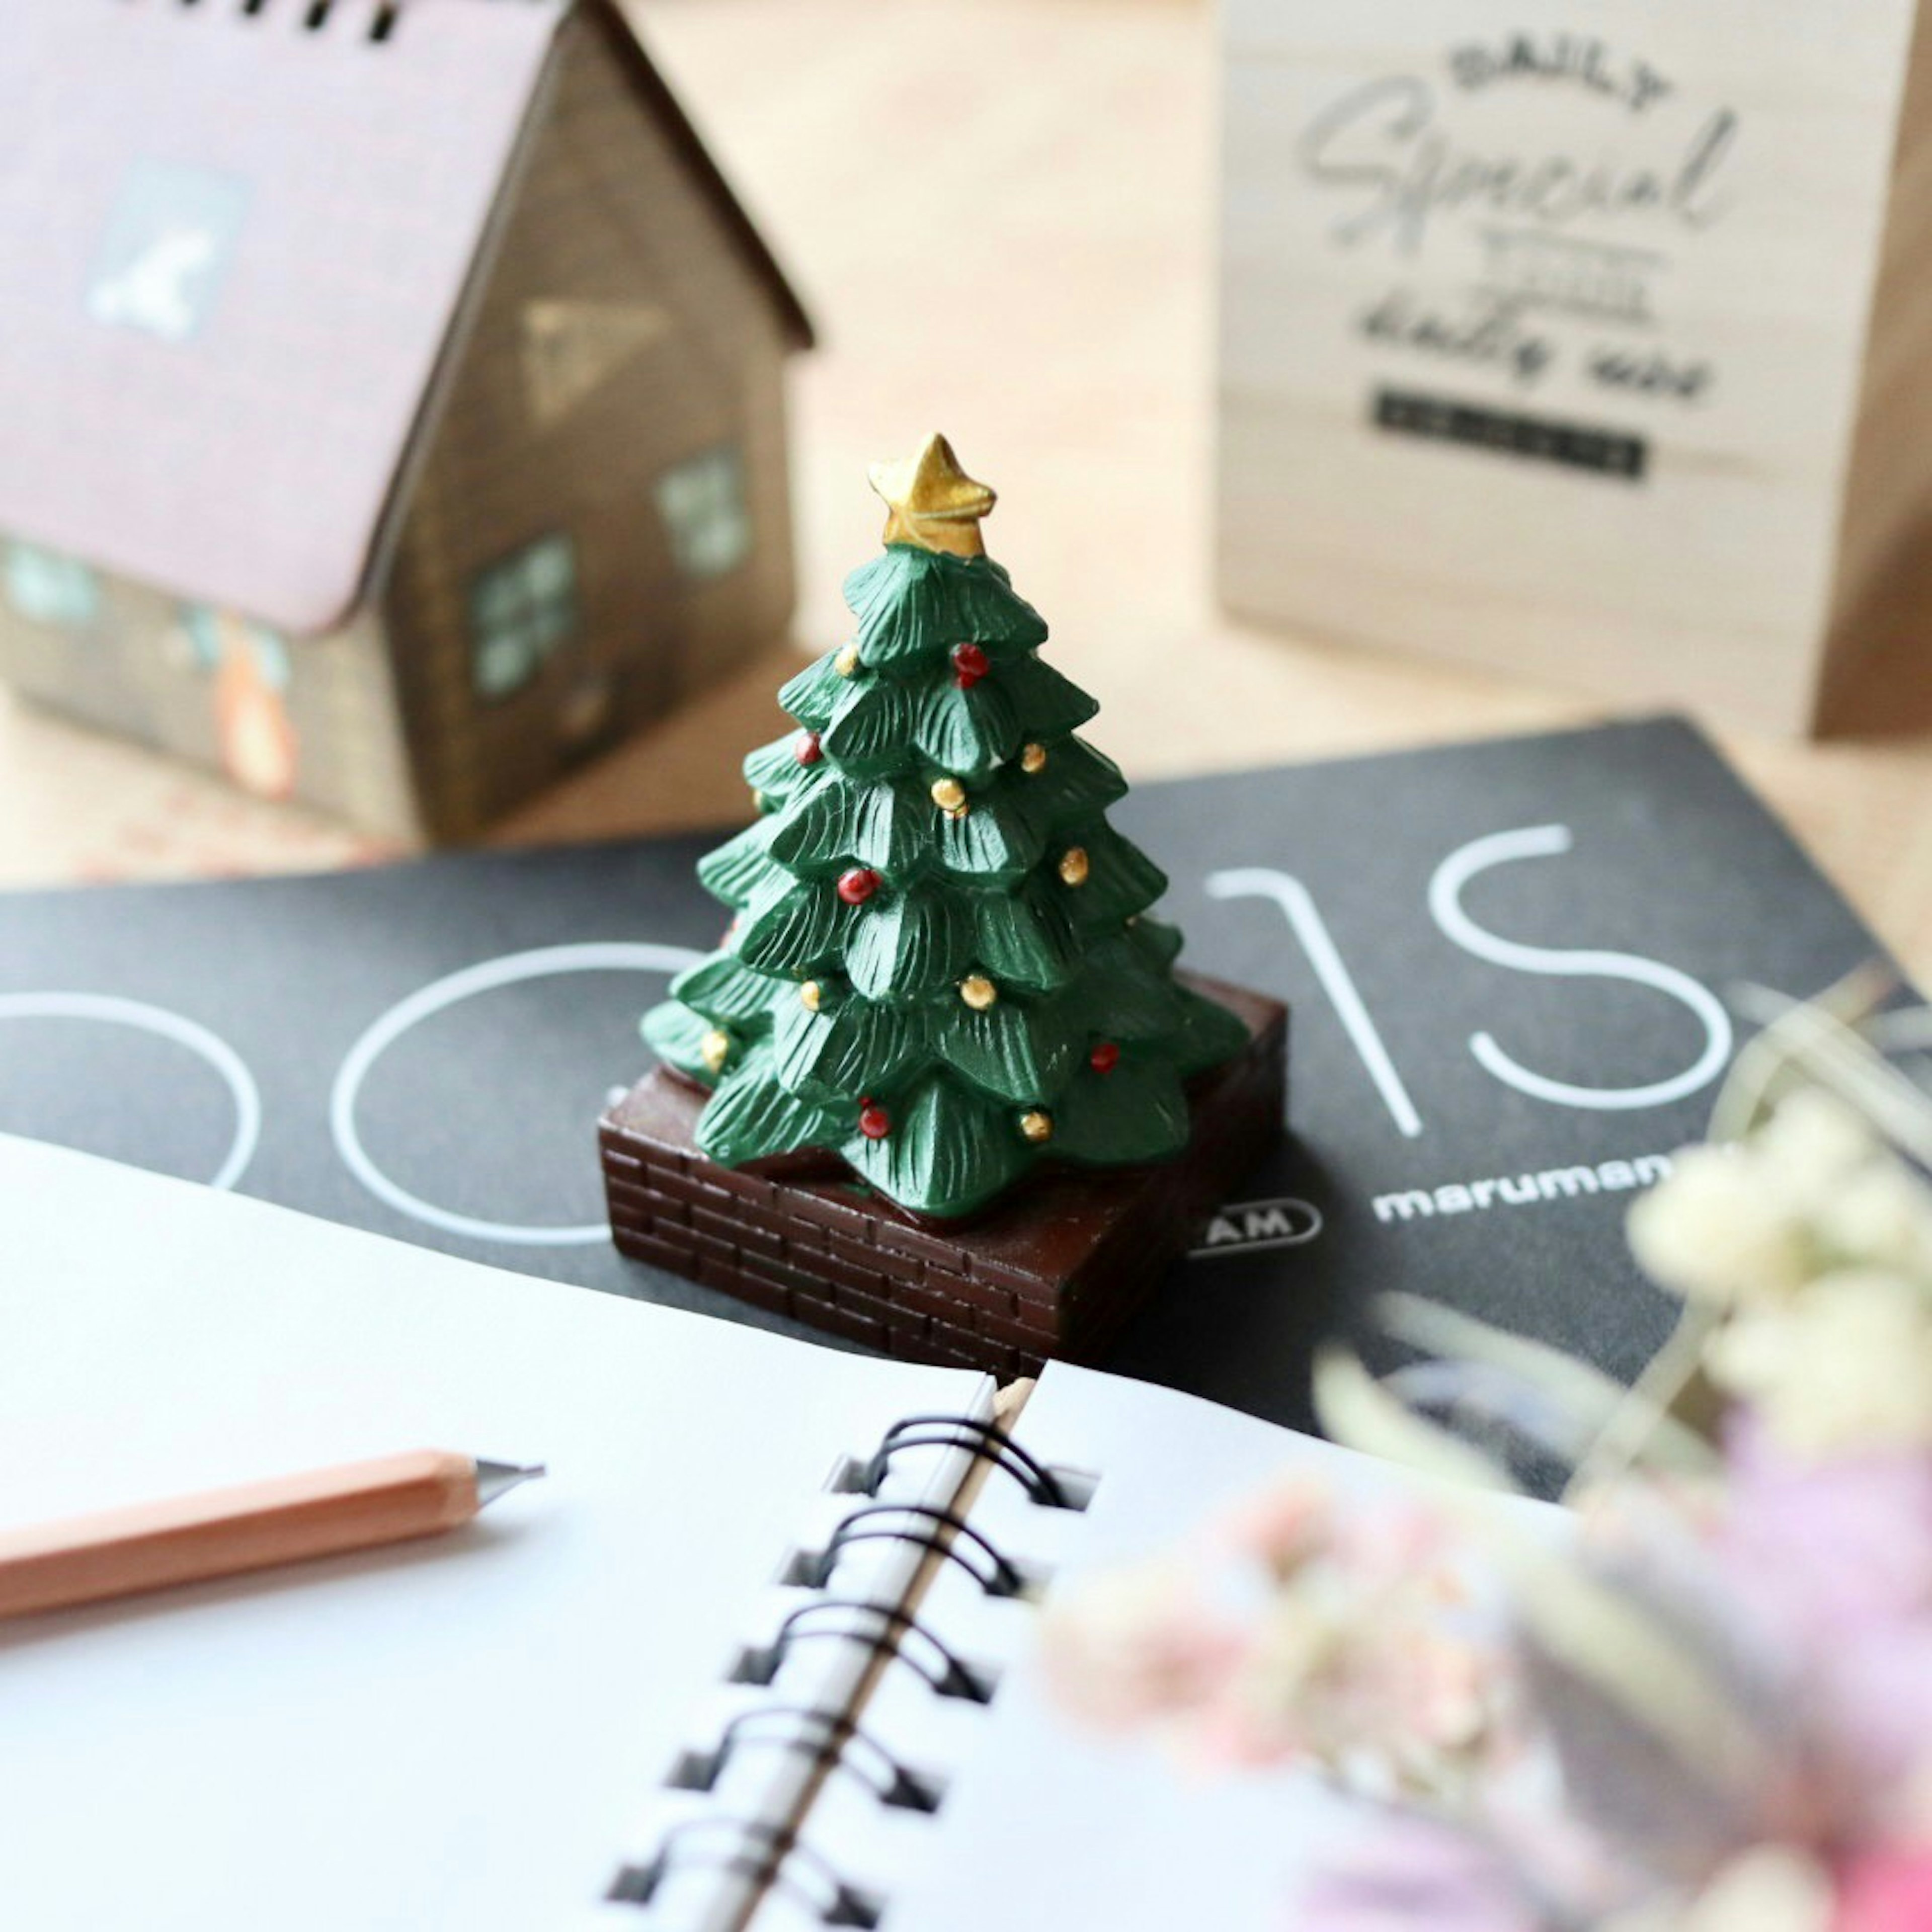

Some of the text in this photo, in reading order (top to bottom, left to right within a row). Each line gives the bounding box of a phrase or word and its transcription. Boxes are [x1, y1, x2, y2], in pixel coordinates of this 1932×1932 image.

[1449, 31, 1671, 110] DAILY
[1298, 74, 1737, 256] Special
[1372, 1154, 1673, 1223] maruman
